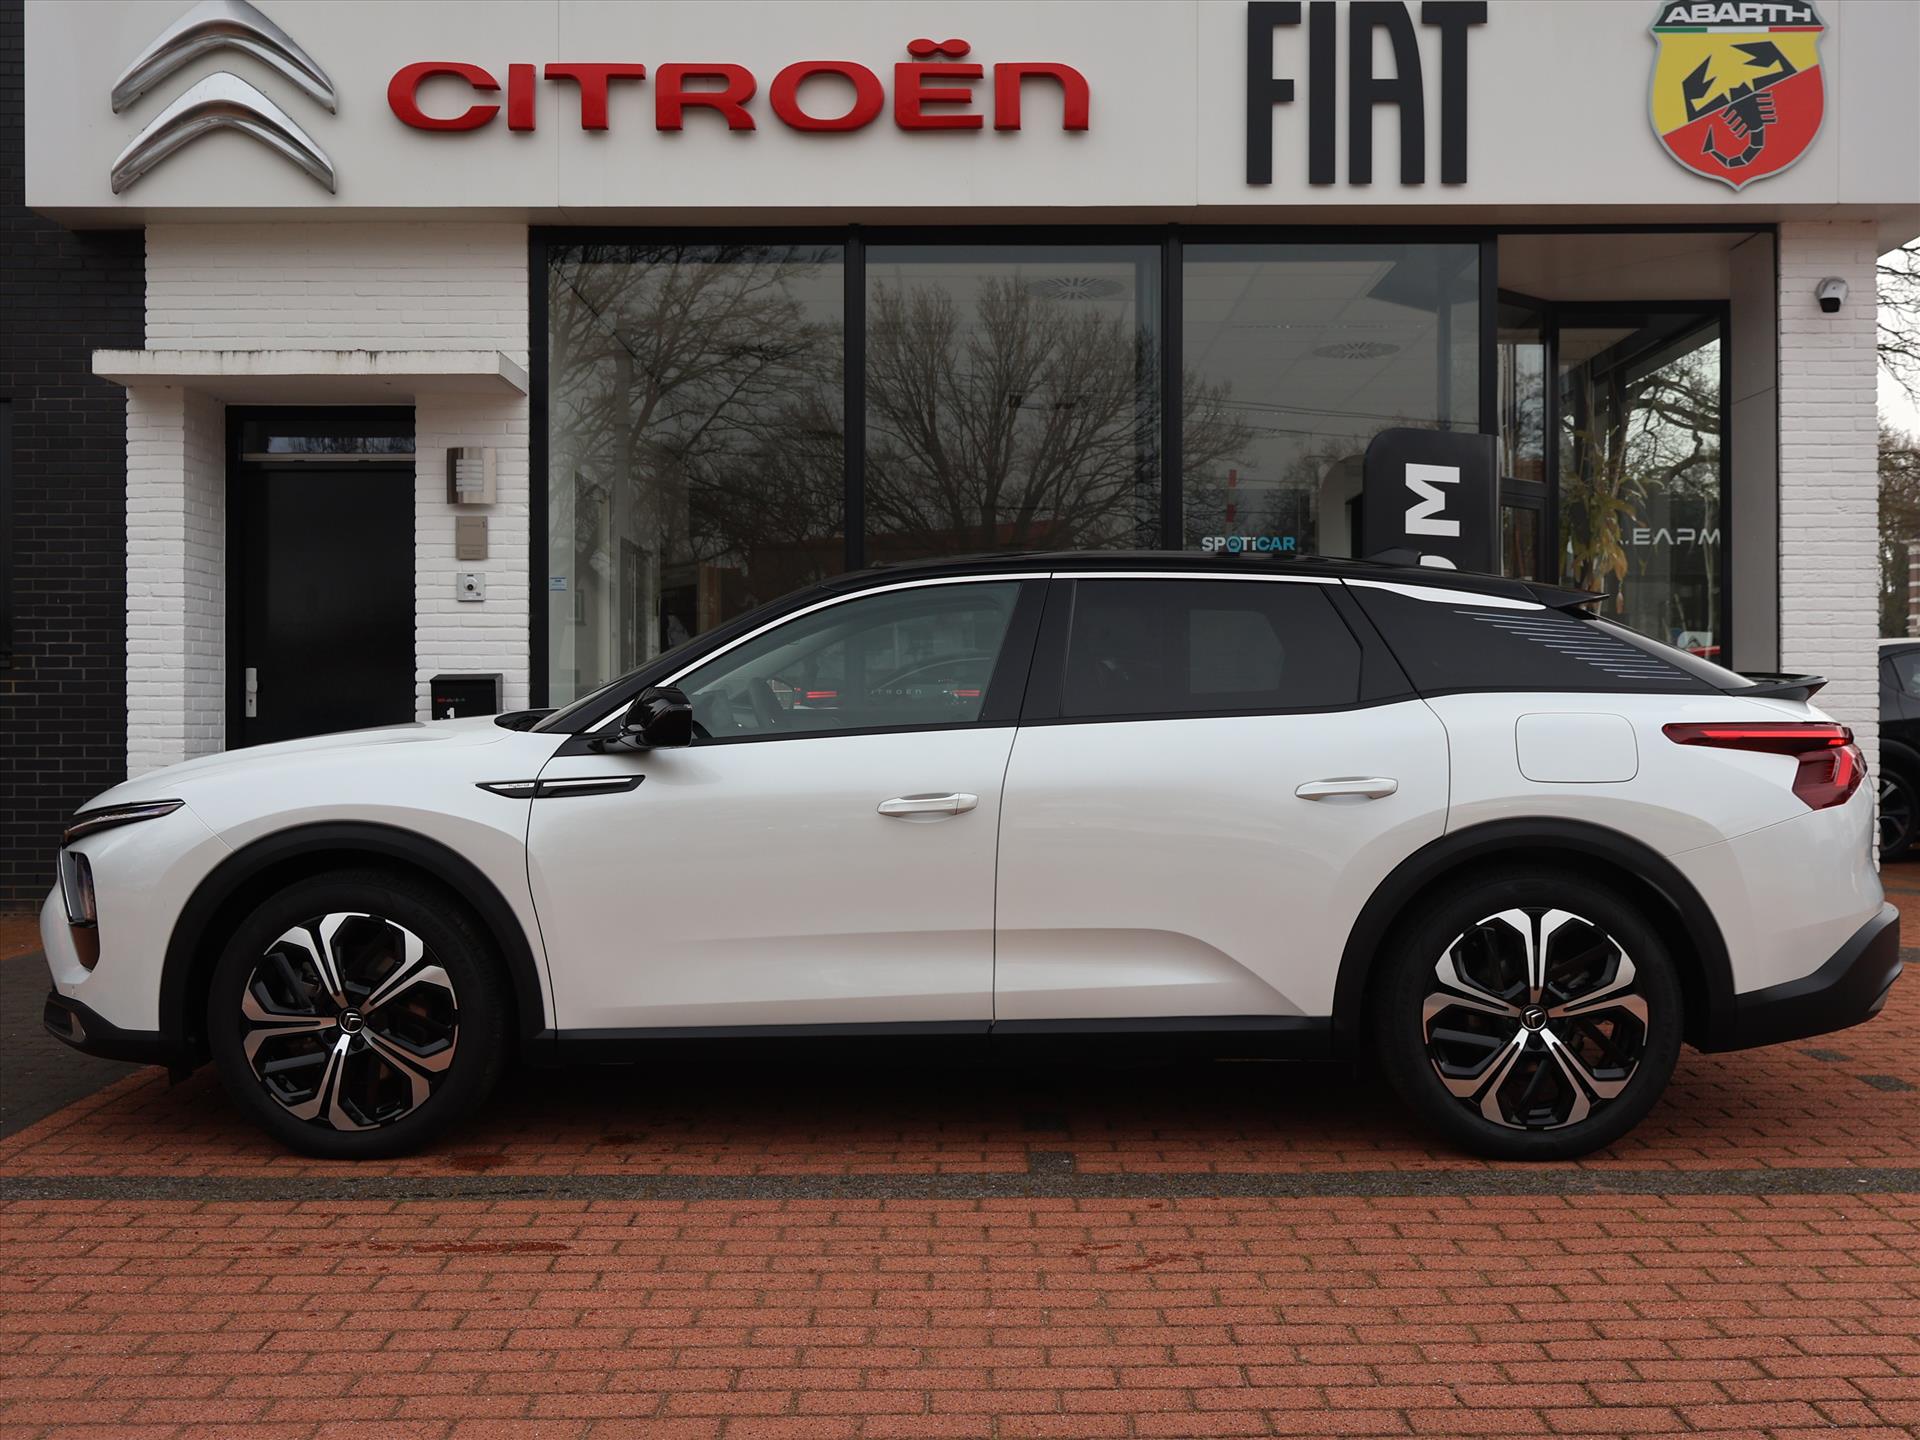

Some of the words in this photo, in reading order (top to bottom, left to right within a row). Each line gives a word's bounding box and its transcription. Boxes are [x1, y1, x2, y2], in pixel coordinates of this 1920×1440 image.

[1665, 2, 1811, 23] ABARTH
[387, 38, 1090, 132] CITROËN
[1247, 1, 1487, 184] FIAT
[1619, 527, 1720, 545] EAPM
